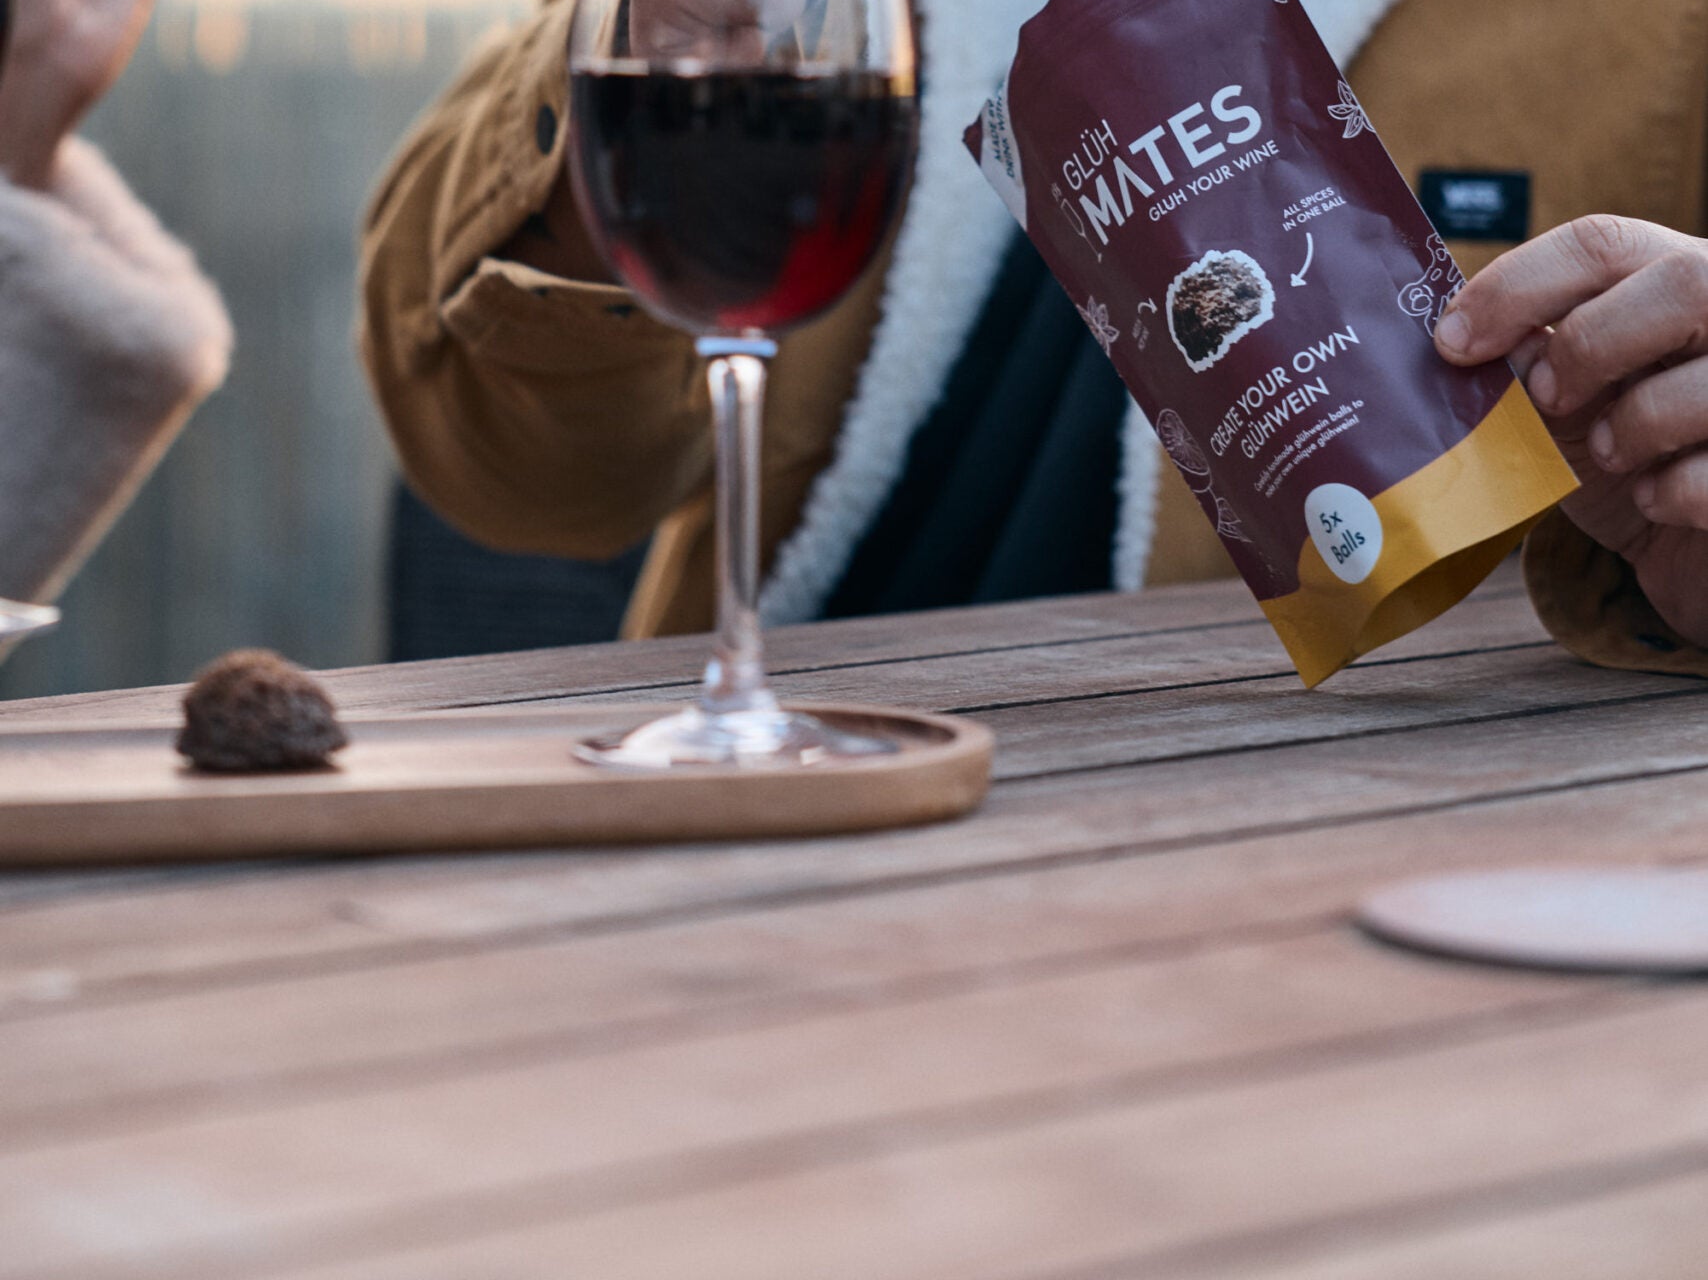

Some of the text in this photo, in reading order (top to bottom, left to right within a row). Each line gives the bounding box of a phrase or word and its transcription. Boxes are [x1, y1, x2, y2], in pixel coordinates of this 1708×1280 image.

[1062, 119, 1118, 191] GLÜH
[1078, 84, 1262, 246] MATES
[1186, 165, 1235, 196] YOUR
[1232, 140, 1280, 172] WINE
[1282, 196, 1347, 232] IN ONE BALL
[1283, 186, 1335, 219] ALL SPICES
[1210, 325, 1361, 457] CREATE YOUR OWN
[1240, 376, 1330, 459] GLÜHWEIN
[1293, 419, 1330, 449] glühwein
[1327, 404, 1353, 422] balls
[1352, 399, 1364, 409] to
[1292, 443, 1318, 465] unique
[1319, 511, 1343, 534] 5x
[1330, 528, 1366, 565] Balls
